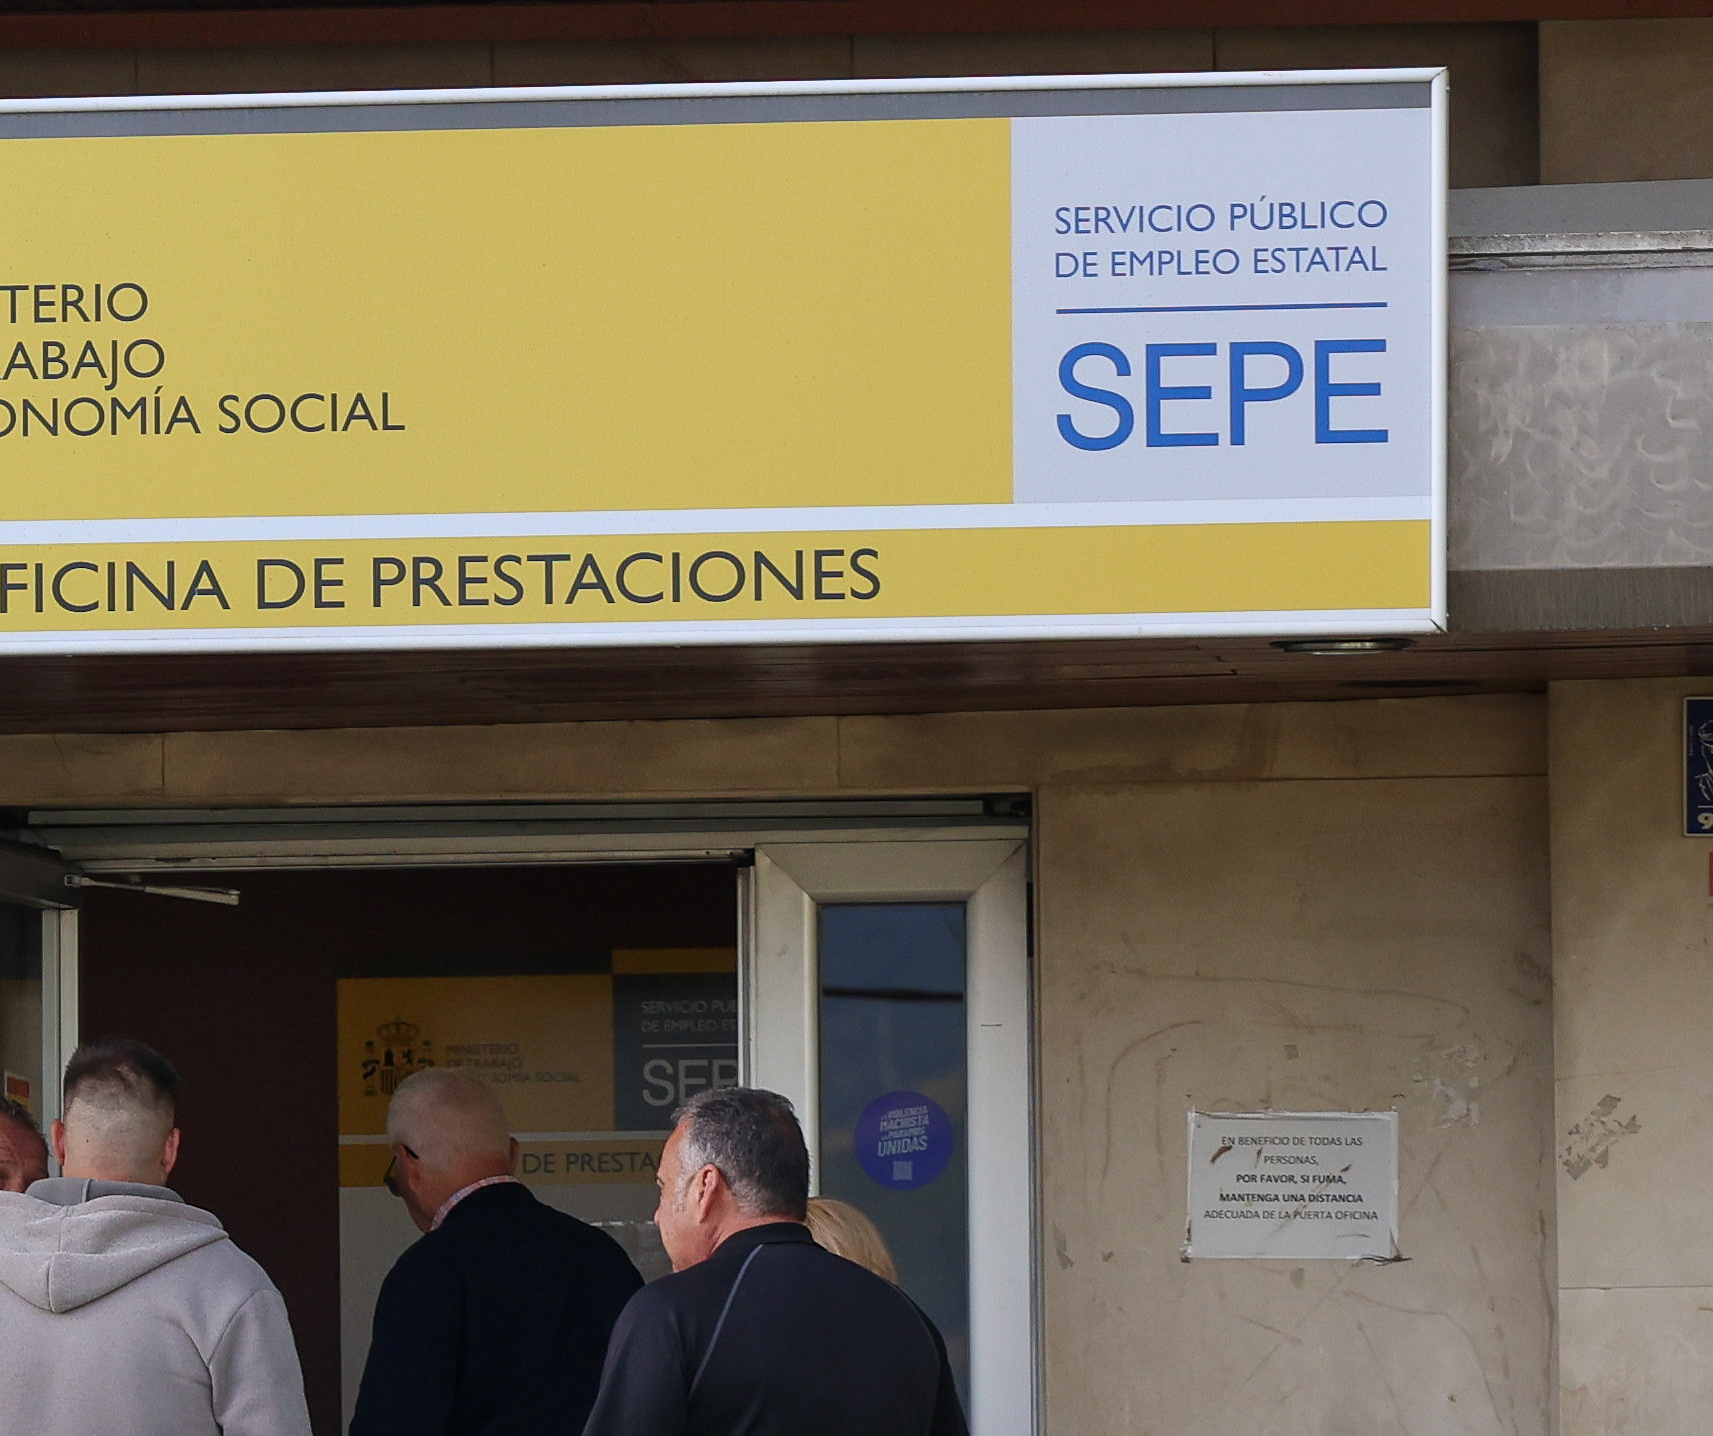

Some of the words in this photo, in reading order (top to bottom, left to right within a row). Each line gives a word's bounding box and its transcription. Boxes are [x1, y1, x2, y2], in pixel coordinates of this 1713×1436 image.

[1055, 203, 1216, 235] SERVICIO
[1229, 195, 1388, 232] PÚBLICO
[1055, 251, 1099, 278] DE
[1111, 248, 1240, 277] EMPLEO
[1253, 245, 1388, 274] ESTATAL
[1056, 338, 1389, 452] SEPE
[218, 391, 406, 434] SOCIAL
[256, 557, 346, 610] DE
[372, 548, 881, 608] PRESTACIONES
[641, 1001, 707, 1014] SERVICIO
[643, 1059, 738, 1106] SEP
[877, 1136, 928, 1157] UNIDAS
[1221, 1136, 1235, 1146] EN
[1238, 1136, 1290, 1146] BENEFICIO
[1292, 1136, 1306, 1146] DE
[1308, 1136, 1343, 1147] TODAS
[1345, 1136, 1363, 1147] LAS
[522, 1153, 556, 1174] DE
[565, 1152, 658, 1173] PRESTA
[1264, 1155, 1318, 1166] PERSONAS,
[1236, 1174, 1258, 1183] POR
[1260, 1174, 1298, 1185] FAVOR,
[1300, 1174, 1310, 1184] SI
[1219, 1193, 1280, 1202] MANTENGA
[1282, 1193, 1306, 1203] UNA
[1308, 1193, 1364, 1203] DISTANCIA
[1204, 1209, 1260, 1219] ADECUADA
[1263, 1210, 1276, 1219] DE
[1278, 1210, 1291, 1220] LA
[1293, 1210, 1333, 1220] PUERTA
[1335, 1210, 1378, 1220] OFICINA
